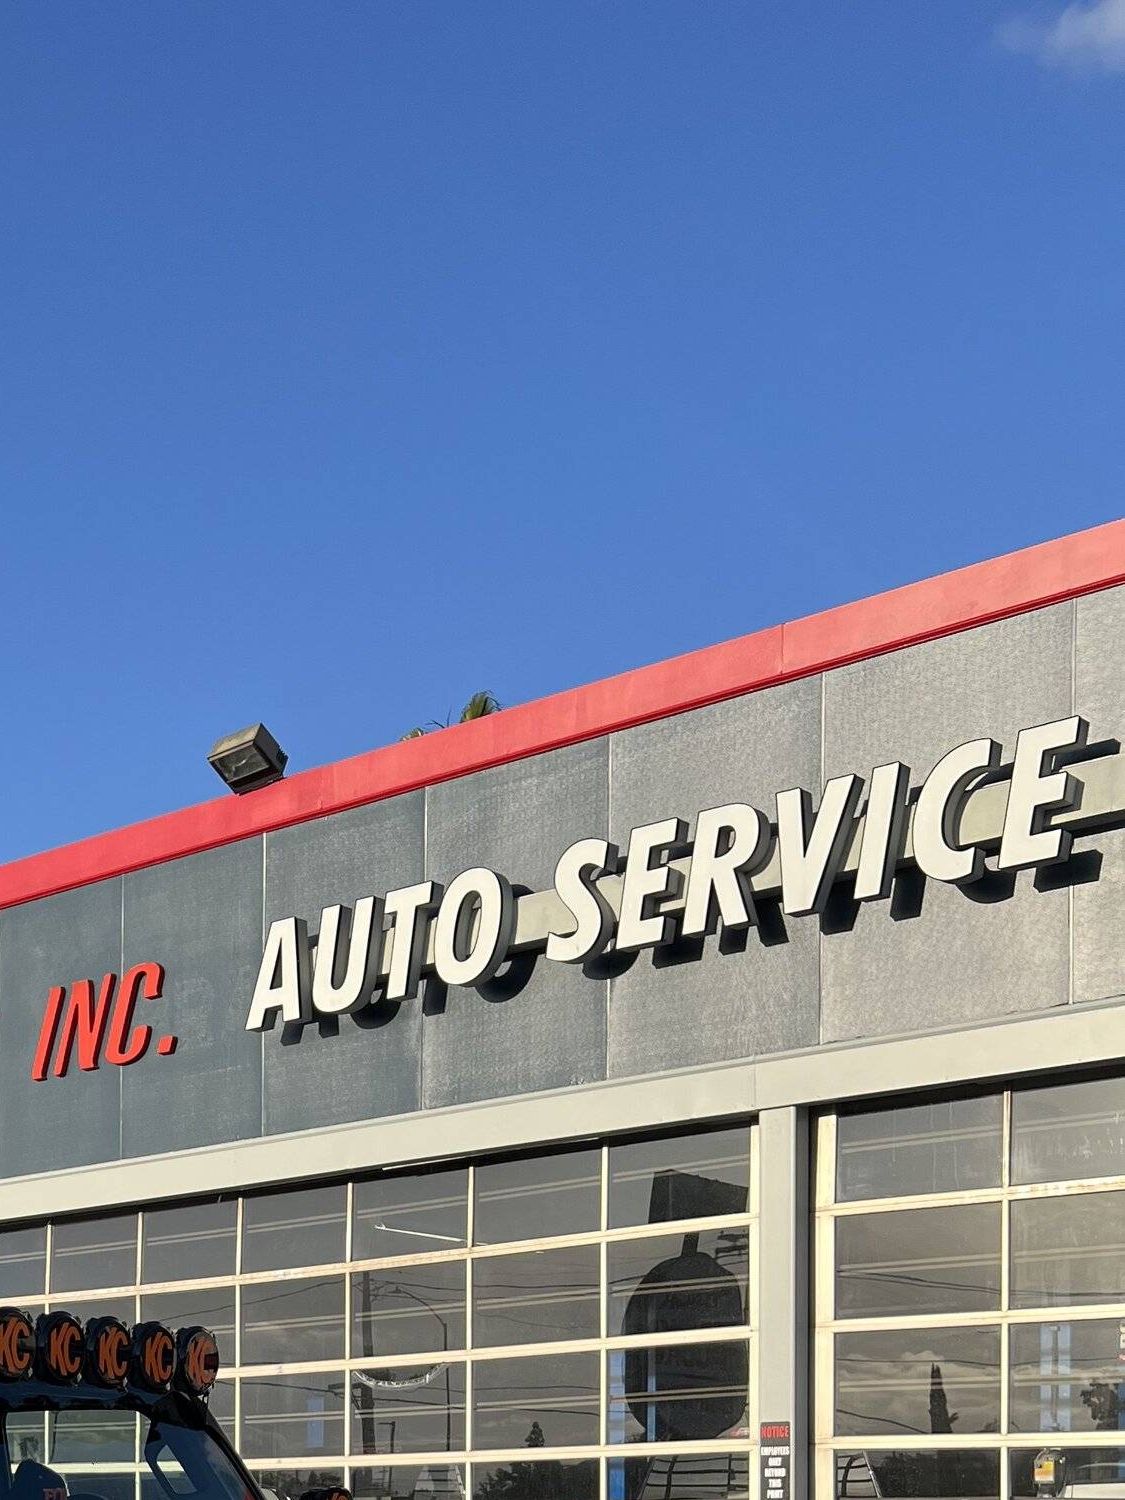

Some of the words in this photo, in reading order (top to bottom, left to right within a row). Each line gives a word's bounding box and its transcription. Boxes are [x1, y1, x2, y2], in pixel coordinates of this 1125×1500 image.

[244, 867, 517, 1032] AUTO
[545, 715, 1089, 965] SERVICE
[32, 961, 179, 1082] INC.
[50, 1322, 81, 1376] KC
[98, 1326, 129, 1380] KC
[144, 1331, 173, 1384] KC
[187, 1336, 217, 1386] KC
[761, 1425, 789, 1438] NOTICE
